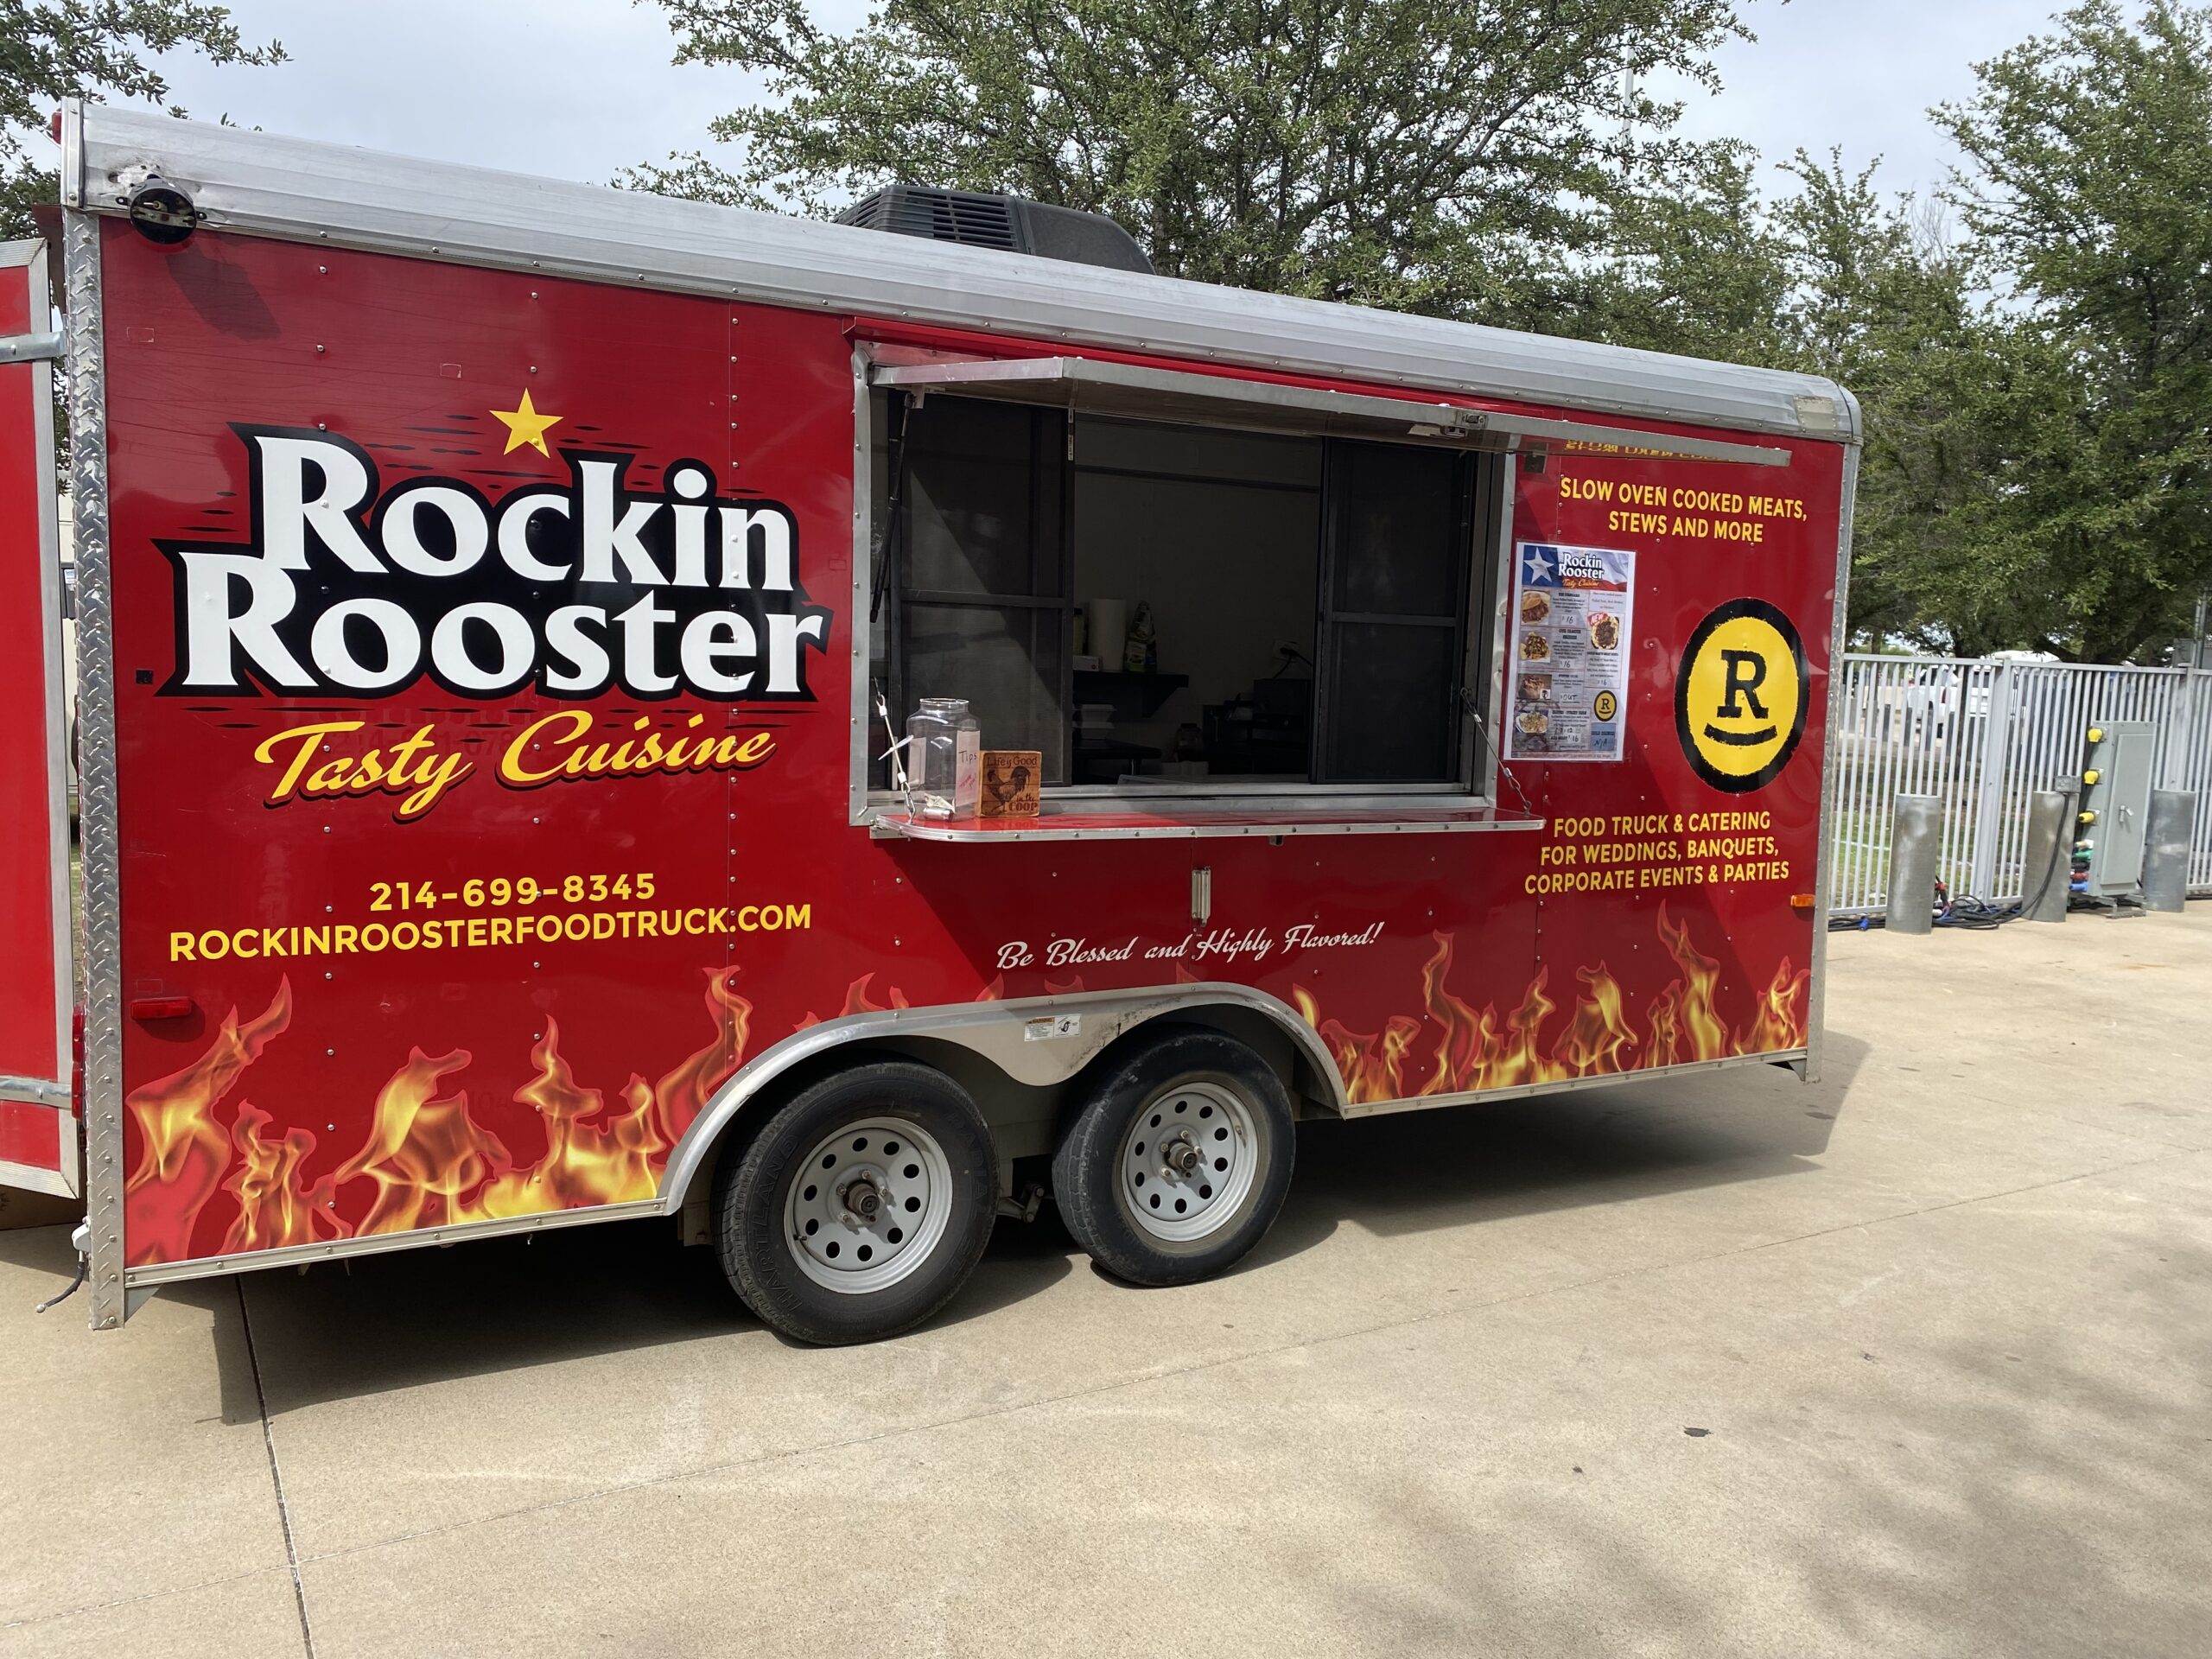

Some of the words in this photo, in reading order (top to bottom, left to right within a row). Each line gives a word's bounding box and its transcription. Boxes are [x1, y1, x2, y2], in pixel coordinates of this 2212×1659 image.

[254, 435, 793, 591] Rockin
[1560, 477, 1613, 501] SLOW
[1618, 483, 1667, 506] OVEN
[1672, 488, 1743, 513] COOKED
[1748, 496, 1807, 521] MEATS,
[1608, 511, 1667, 535] STEWS
[1671, 517, 1708, 537] AND
[1713, 520, 1763, 542] MORE
[1558, 563, 1604, 579] Rooster
[1563, 553, 1602, 569] Rockin
[181, 552, 823, 693] Rooster
[1591, 613, 1604, 625] NEW
[1717, 649, 1769, 719] R
[254, 720, 473, 815] Tasty
[495, 710, 776, 782] Cuisine
[959, 750, 977, 765] Tips
[987, 756, 1006, 766] Life
[1013, 756, 1038, 766] Good
[1009, 802, 1038, 811] COOP
[1554, 817, 1605, 837] FOOD
[1612, 815, 1669, 835] TRUCK
[1674, 814, 1683, 833] &
[1688, 811, 1770, 832] CATERING
[1541, 846, 1576, 866] FOR
[1583, 842, 1681, 863] WEDDINGS,
[1688, 836, 1779, 859] BANQUETS,
[369, 873, 656, 912] 214-699-8345
[1525, 870, 1634, 894] CORPORATE
[1641, 866, 1703, 887] EVENTS
[1708, 864, 1718, 883] &
[1724, 861, 1789, 882] PARTIES
[169, 904, 812, 962] ROCKINROOSTERFOODTRUCK.COM
[996, 941, 1033, 969] Be
[1046, 937, 1140, 967] Blessed
[1144, 934, 1192, 960] and
[1195, 927, 1275, 963] Highly
[1281, 921, 1385, 953] Flavored!
